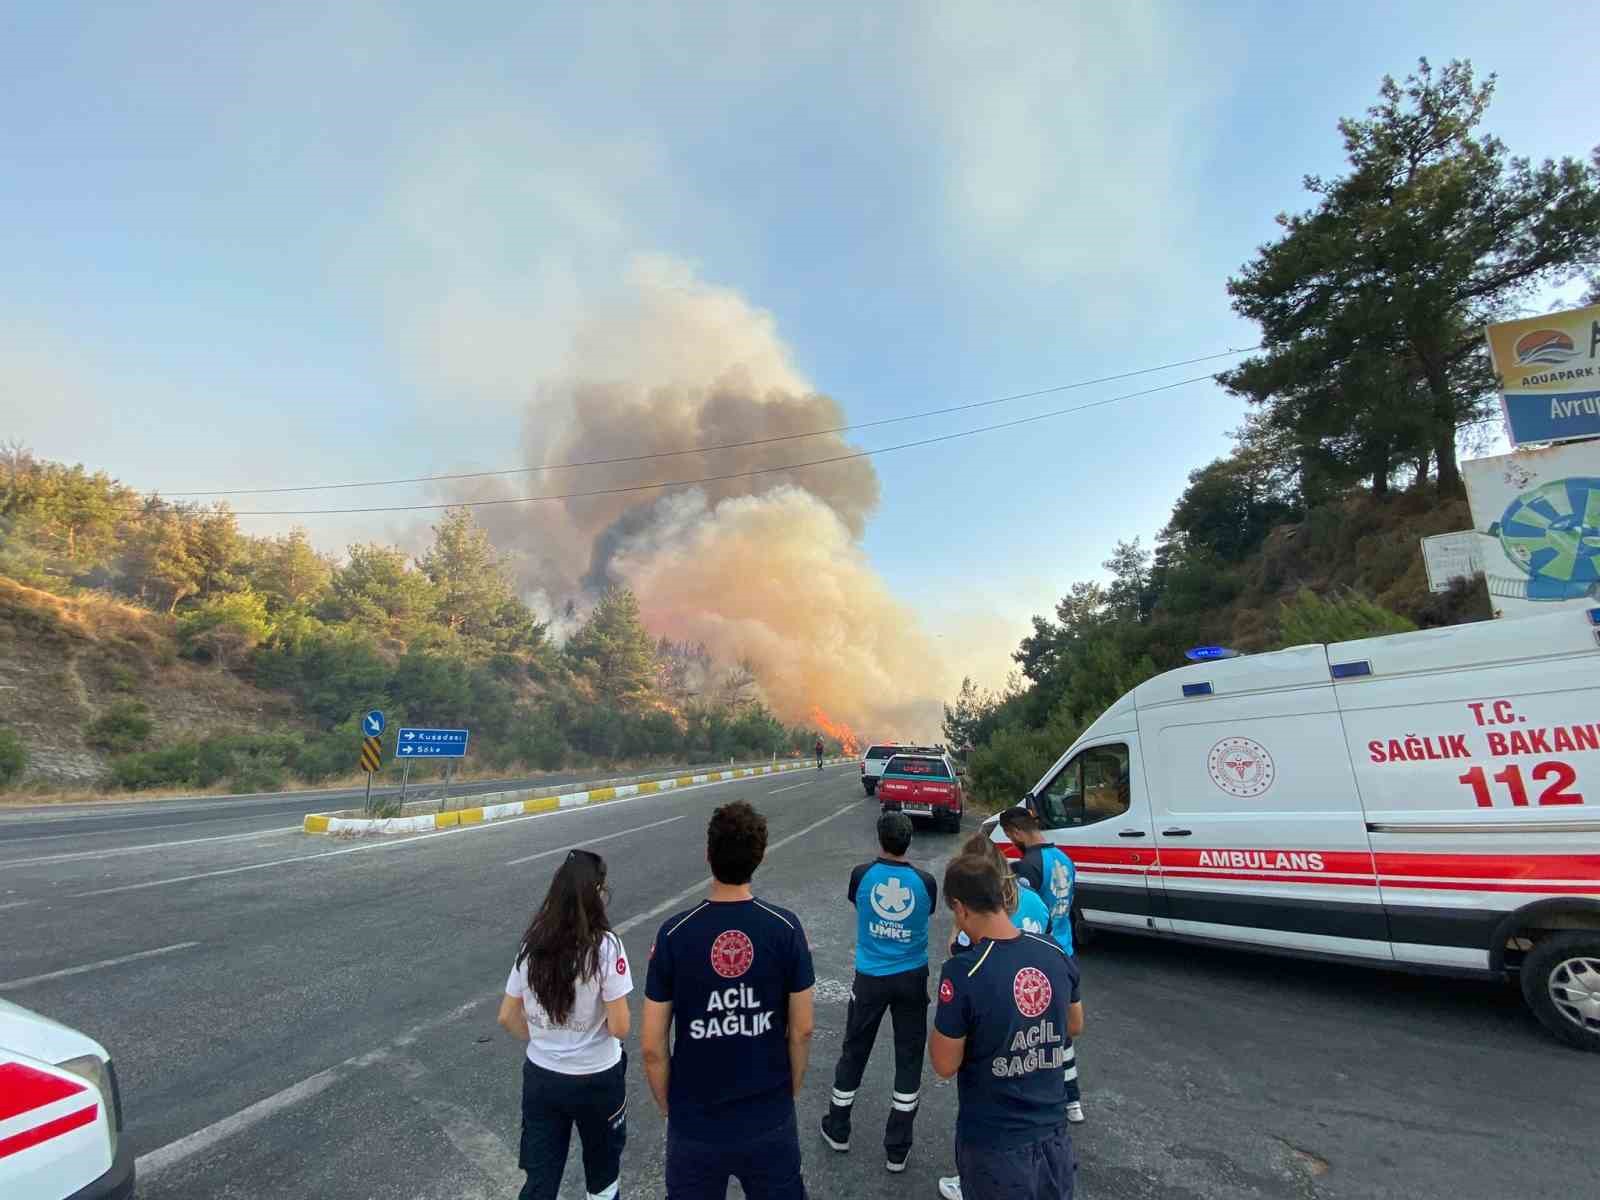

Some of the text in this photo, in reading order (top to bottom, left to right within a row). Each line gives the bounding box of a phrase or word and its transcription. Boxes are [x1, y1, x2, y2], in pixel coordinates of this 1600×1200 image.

[1521, 366, 1594, 387] AQUAPARK
[1467, 700, 1527, 726] T.C.
[1367, 723, 1600, 763] SAĞLIK BAKAN
[1458, 761, 1585, 807] 112
[1199, 851, 1325, 871] AMBULANS
[869, 921, 913, 939] UMKE
[706, 982, 761, 1012] ACİL
[689, 1010, 775, 1040] SAĞLIK
[1010, 1019, 1061, 1052] ACİL
